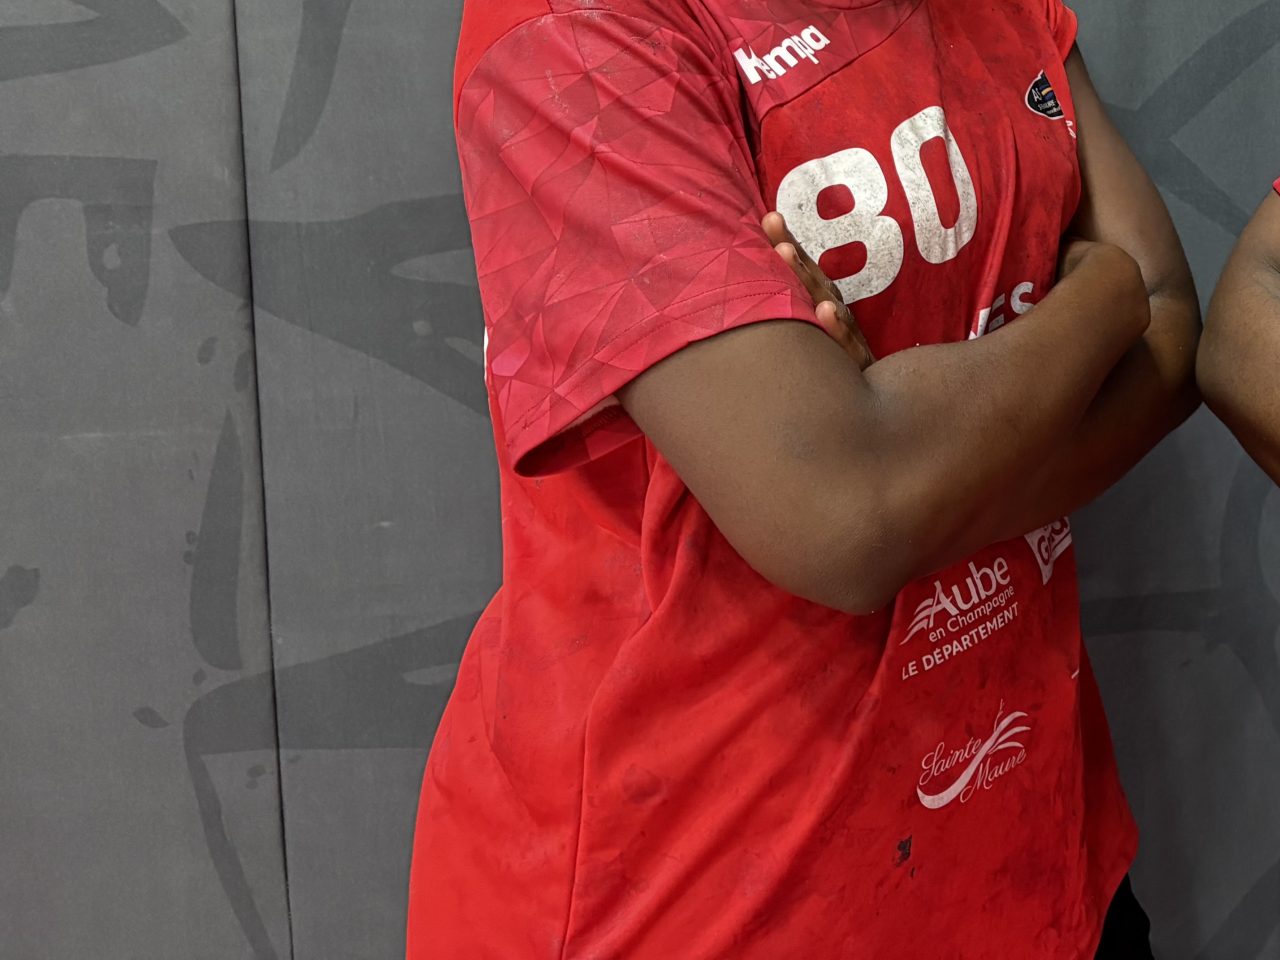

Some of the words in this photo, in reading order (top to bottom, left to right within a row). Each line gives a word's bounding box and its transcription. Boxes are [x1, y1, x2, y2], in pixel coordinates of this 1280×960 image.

[775, 105, 978, 305] 80
[926, 557, 1011, 630] Aube
[928, 628, 946, 642] en
[947, 586, 1015, 632] Champagne
[902, 660, 919, 681] LE
[922, 601, 1019, 671] DÉPARTEMENT
[919, 737, 981, 786] Sainte
[960, 748, 1026, 803] Maure
